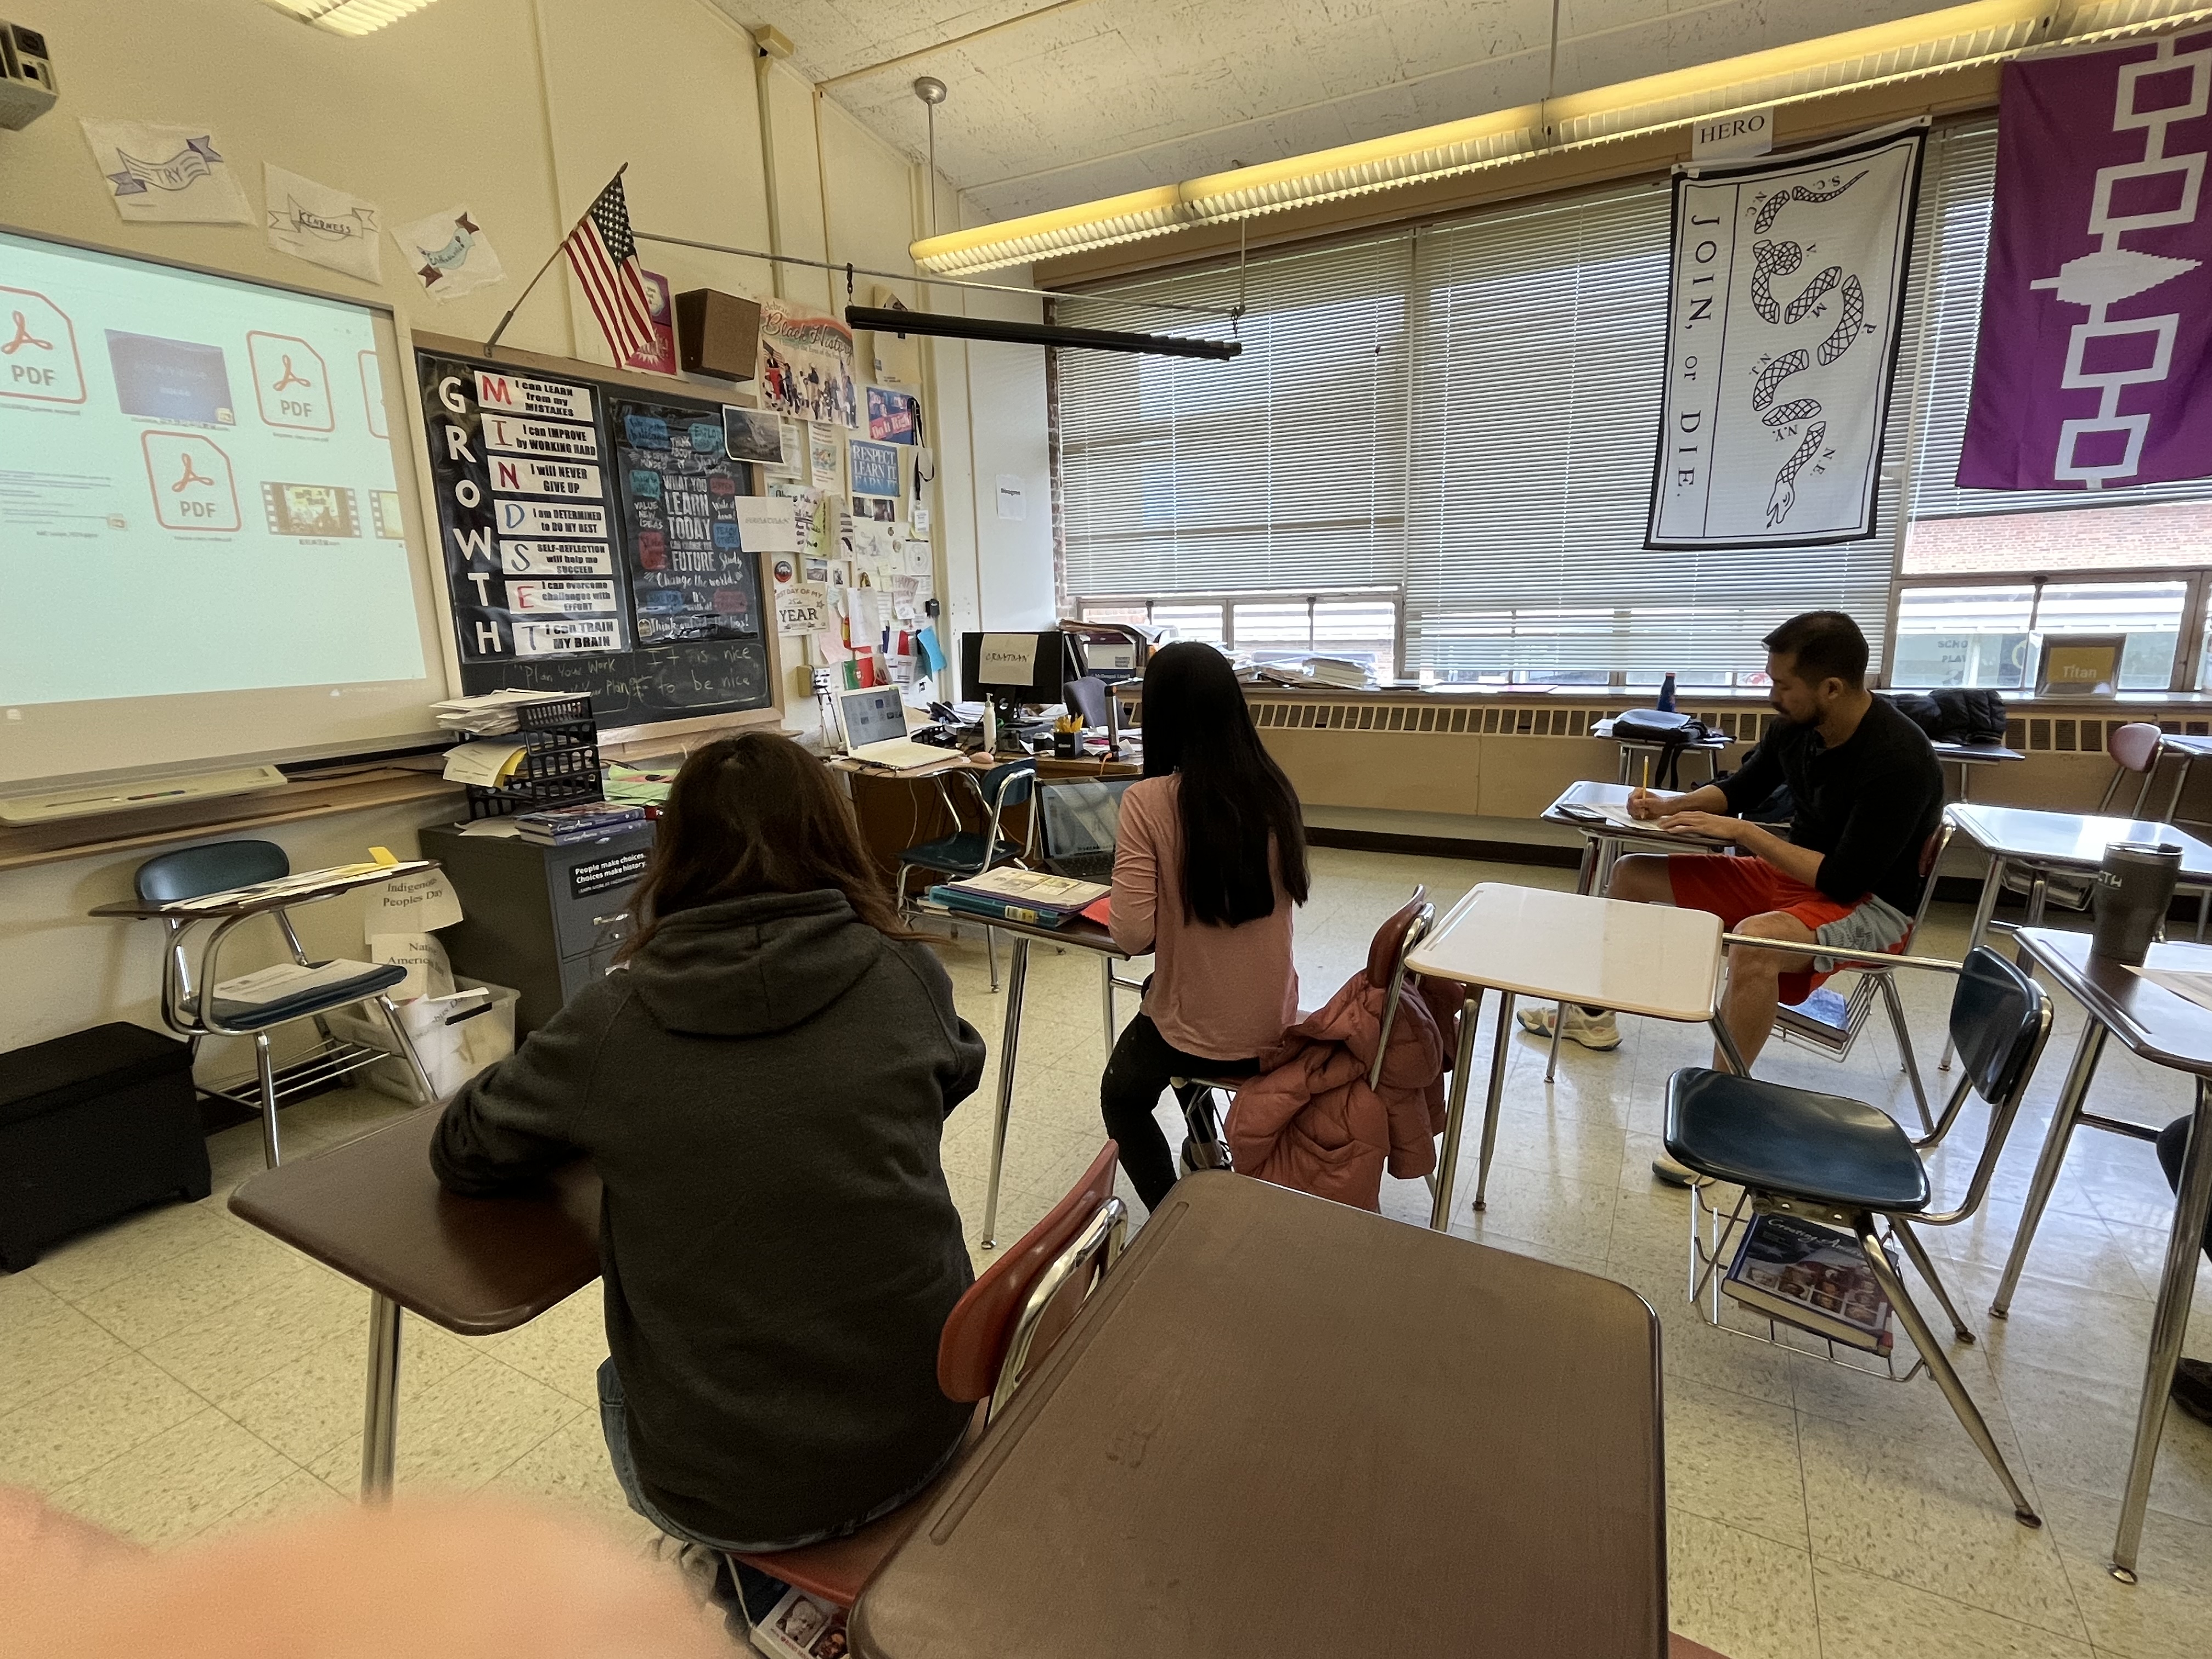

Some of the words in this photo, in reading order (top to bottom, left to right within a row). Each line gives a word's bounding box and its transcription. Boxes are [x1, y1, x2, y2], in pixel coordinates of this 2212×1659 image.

[1700, 115, 1764, 144] HERO
[155, 167, 185, 185] TRY
[299, 210, 351, 234] KINDNESS
[1685, 214, 1720, 329] JOIN,
[762, 312, 806, 342] Black
[810, 323, 854, 366] History
[11, 365, 56, 386] PDF
[1684, 356, 1697, 380] or
[522, 382, 541, 391] can
[544, 385, 573, 396] LEARN
[526, 392, 551, 403] from
[554, 397, 568, 406] my
[280, 399, 313, 418] PDF
[525, 403, 574, 416] MISTAKES
[529, 427, 546, 437] can
[548, 427, 587, 441] IMPROVE
[516, 438, 527, 449] by
[529, 439, 572, 453] WORKING
[574, 444, 596, 456] HARD
[1678, 410, 1701, 496] DIE.
[536, 465, 556, 477] will
[558, 466, 588, 479] NEVER
[854, 460, 885, 479] LEARN
[543, 480, 566, 493] GIVE
[568, 483, 580, 493] UP
[662, 475, 688, 491] WHAT
[690, 477, 707, 493] YOU
[180, 501, 217, 519] PDF
[634, 501, 658, 510] VALUE
[664, 491, 709, 516] LEARN
[539, 510, 551, 518] am
[554, 510, 601, 521] DETERMINED
[639, 510, 656, 519] NEW
[541, 522, 549, 531] to
[552, 523, 563, 532] DO
[565, 523, 576, 532] MY
[579, 524, 597, 533] BEST
[640, 520, 663, 529] IDEAS
[667, 516, 710, 540] TODAY
[537, 544, 605, 554] SELF-REFLECTION
[565, 555, 583, 563] help
[672, 551, 716, 572] FUTURE
[556, 566, 593, 574] SUCCEED
[657, 572, 692, 589] Change
[695, 574, 707, 588] the
[542, 592, 591, 601] challenges
[593, 591, 611, 600] with
[564, 603, 592, 611] EFFORT
[779, 608, 818, 623] YEAR
[554, 624, 576, 634] can
[579, 622, 613, 633] TRAIN
[553, 639, 571, 649] MY
[574, 636, 610, 648] BRAIN
[696, 650, 708, 663] is
[723, 646, 752, 663] nice
[588, 658, 616, 674] Work
[2063, 664, 2097, 679] Titan
[658, 676, 676, 694] to
[691, 669, 714, 691] be
[575, 864, 600, 875] People
[601, 859, 620, 869] make
[576, 872, 603, 884] Choices
[604, 867, 623, 877] make
[383, 894, 423, 908] Peoples
[426, 888, 444, 900] Day
[1768, 1219, 1818, 1243] Creating
